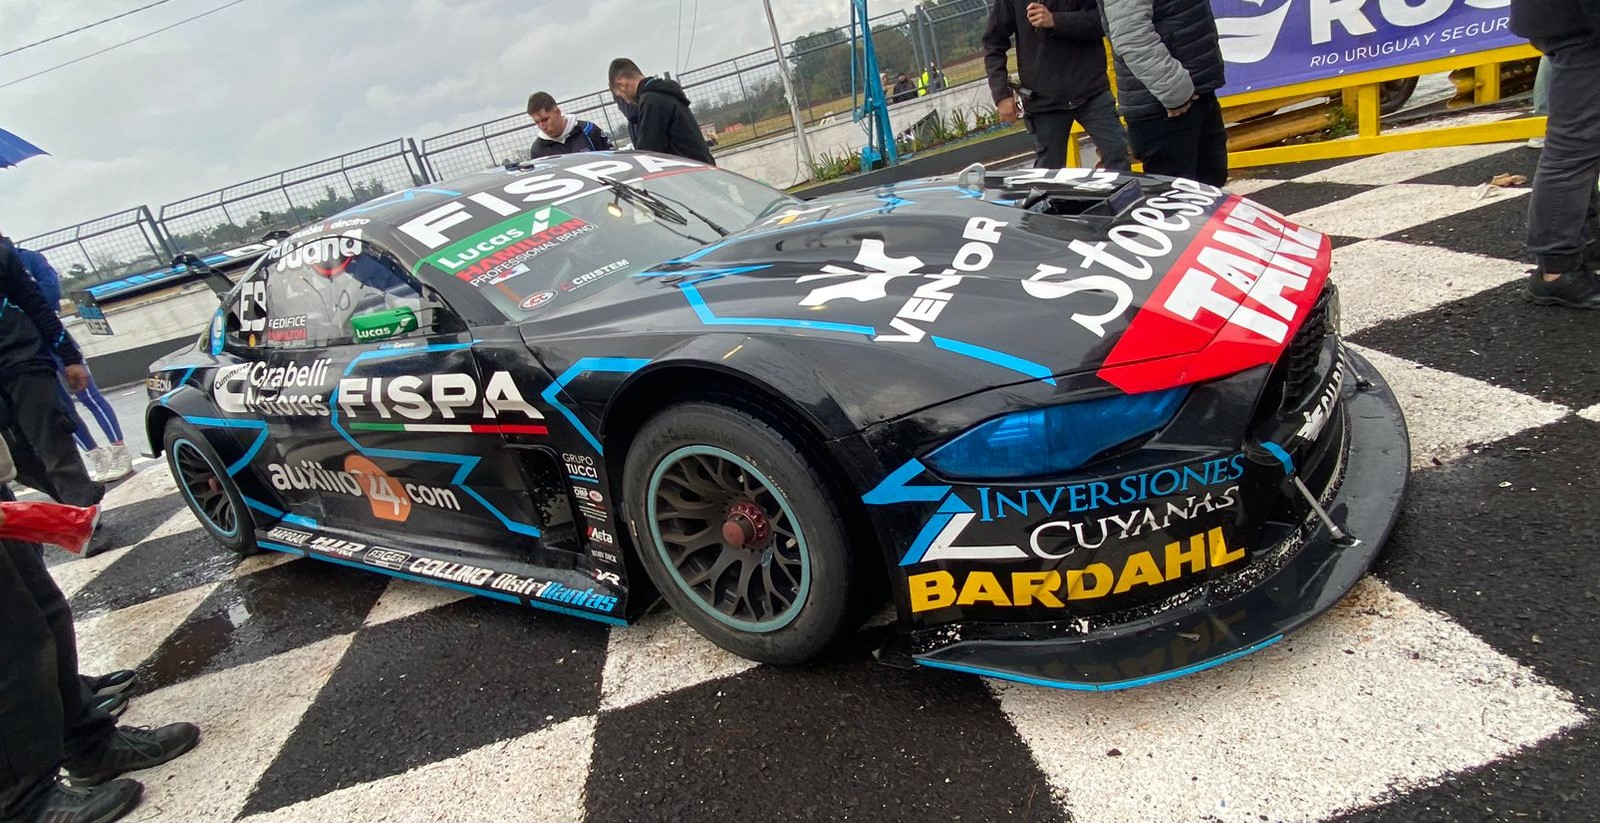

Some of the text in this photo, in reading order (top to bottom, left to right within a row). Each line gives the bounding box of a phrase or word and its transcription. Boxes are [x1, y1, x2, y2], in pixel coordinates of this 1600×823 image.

[1310, 52, 1339, 68] RIO
[1345, 32, 1436, 62] URUGUAY
[397, 154, 706, 249] FISPA
[437, 227, 525, 270] Lucas
[456, 217, 588, 282] HAMILTON
[470, 223, 595, 287] PROFESSIONAL BRAND
[572, 258, 630, 285] CRISTEM
[272, 315, 306, 329] EDIFICE
[356, 327, 391, 338] Lucas
[250, 358, 332, 388] Carabelli
[244, 387, 330, 416] Motores
[338, 371, 545, 420] FISPA
[562, 452, 594, 466] GRUPO
[565, 463, 598, 479] TUCCI
[977, 453, 1245, 522] INVERSIONES
[1029, 486, 1239, 560] CUYANAS
[409, 557, 494, 585] COLLINO
[908, 526, 1245, 612] BARDAHL
